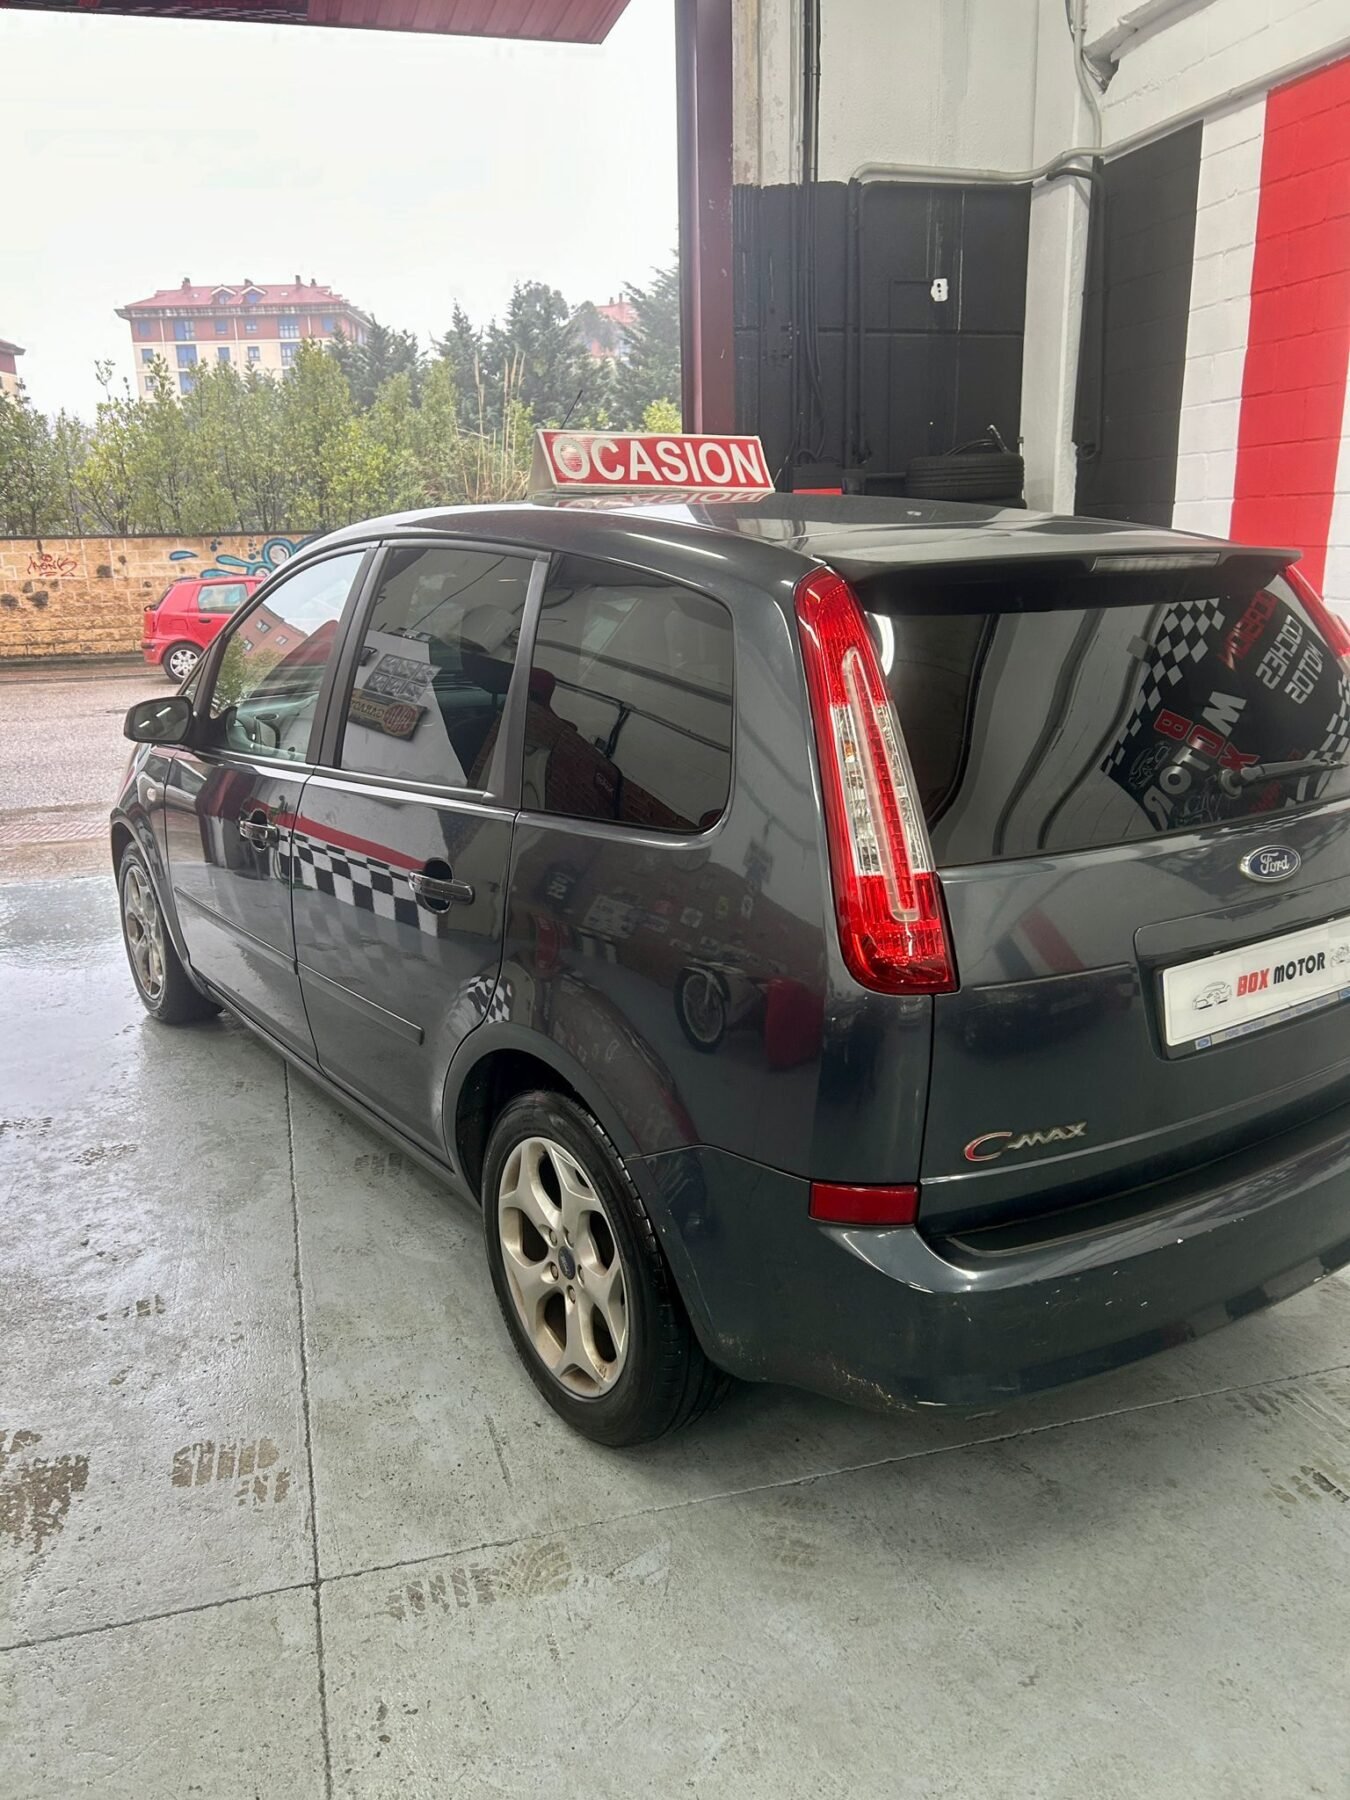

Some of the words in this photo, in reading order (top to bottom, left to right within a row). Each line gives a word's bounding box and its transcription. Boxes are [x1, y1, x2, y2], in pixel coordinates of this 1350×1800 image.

[552, 436, 765, 484] OCASION
[1259, 852, 1290, 875] Ford
[1236, 967, 1270, 998] BOX
[1273, 952, 1326, 985] MOTOR
